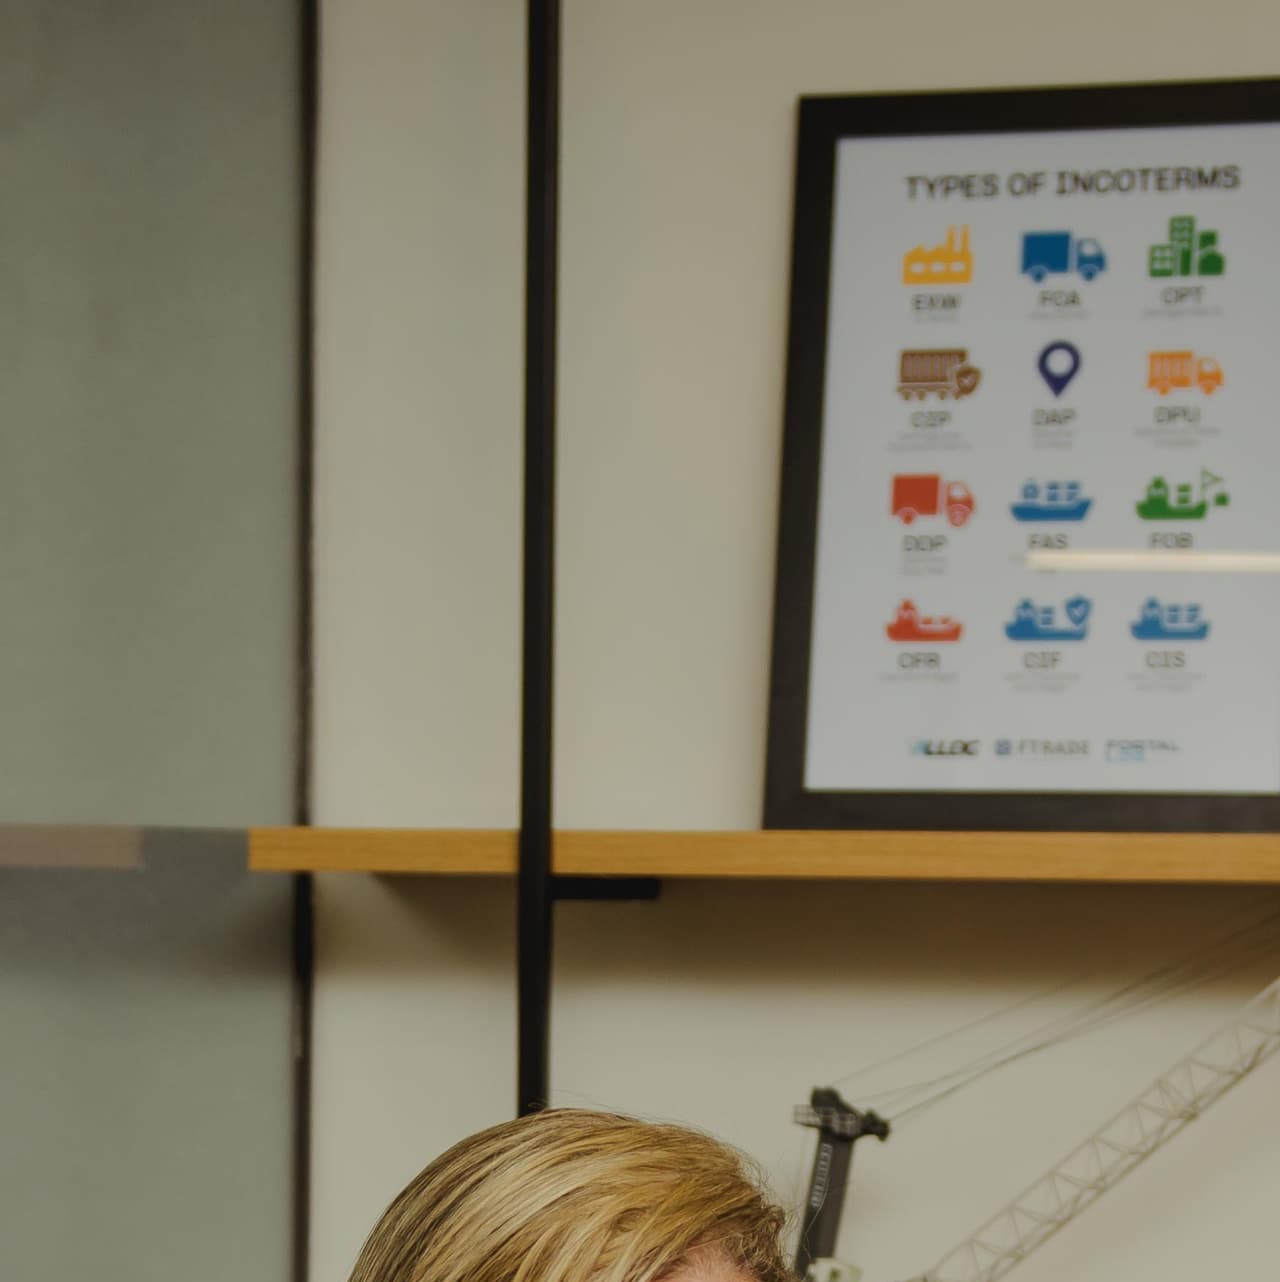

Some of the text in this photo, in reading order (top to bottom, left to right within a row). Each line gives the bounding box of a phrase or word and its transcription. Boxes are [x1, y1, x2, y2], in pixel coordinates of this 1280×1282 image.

[905, 164, 1242, 200] TYPES OF INCOTERMS
[1027, 532, 1069, 550] FAS
